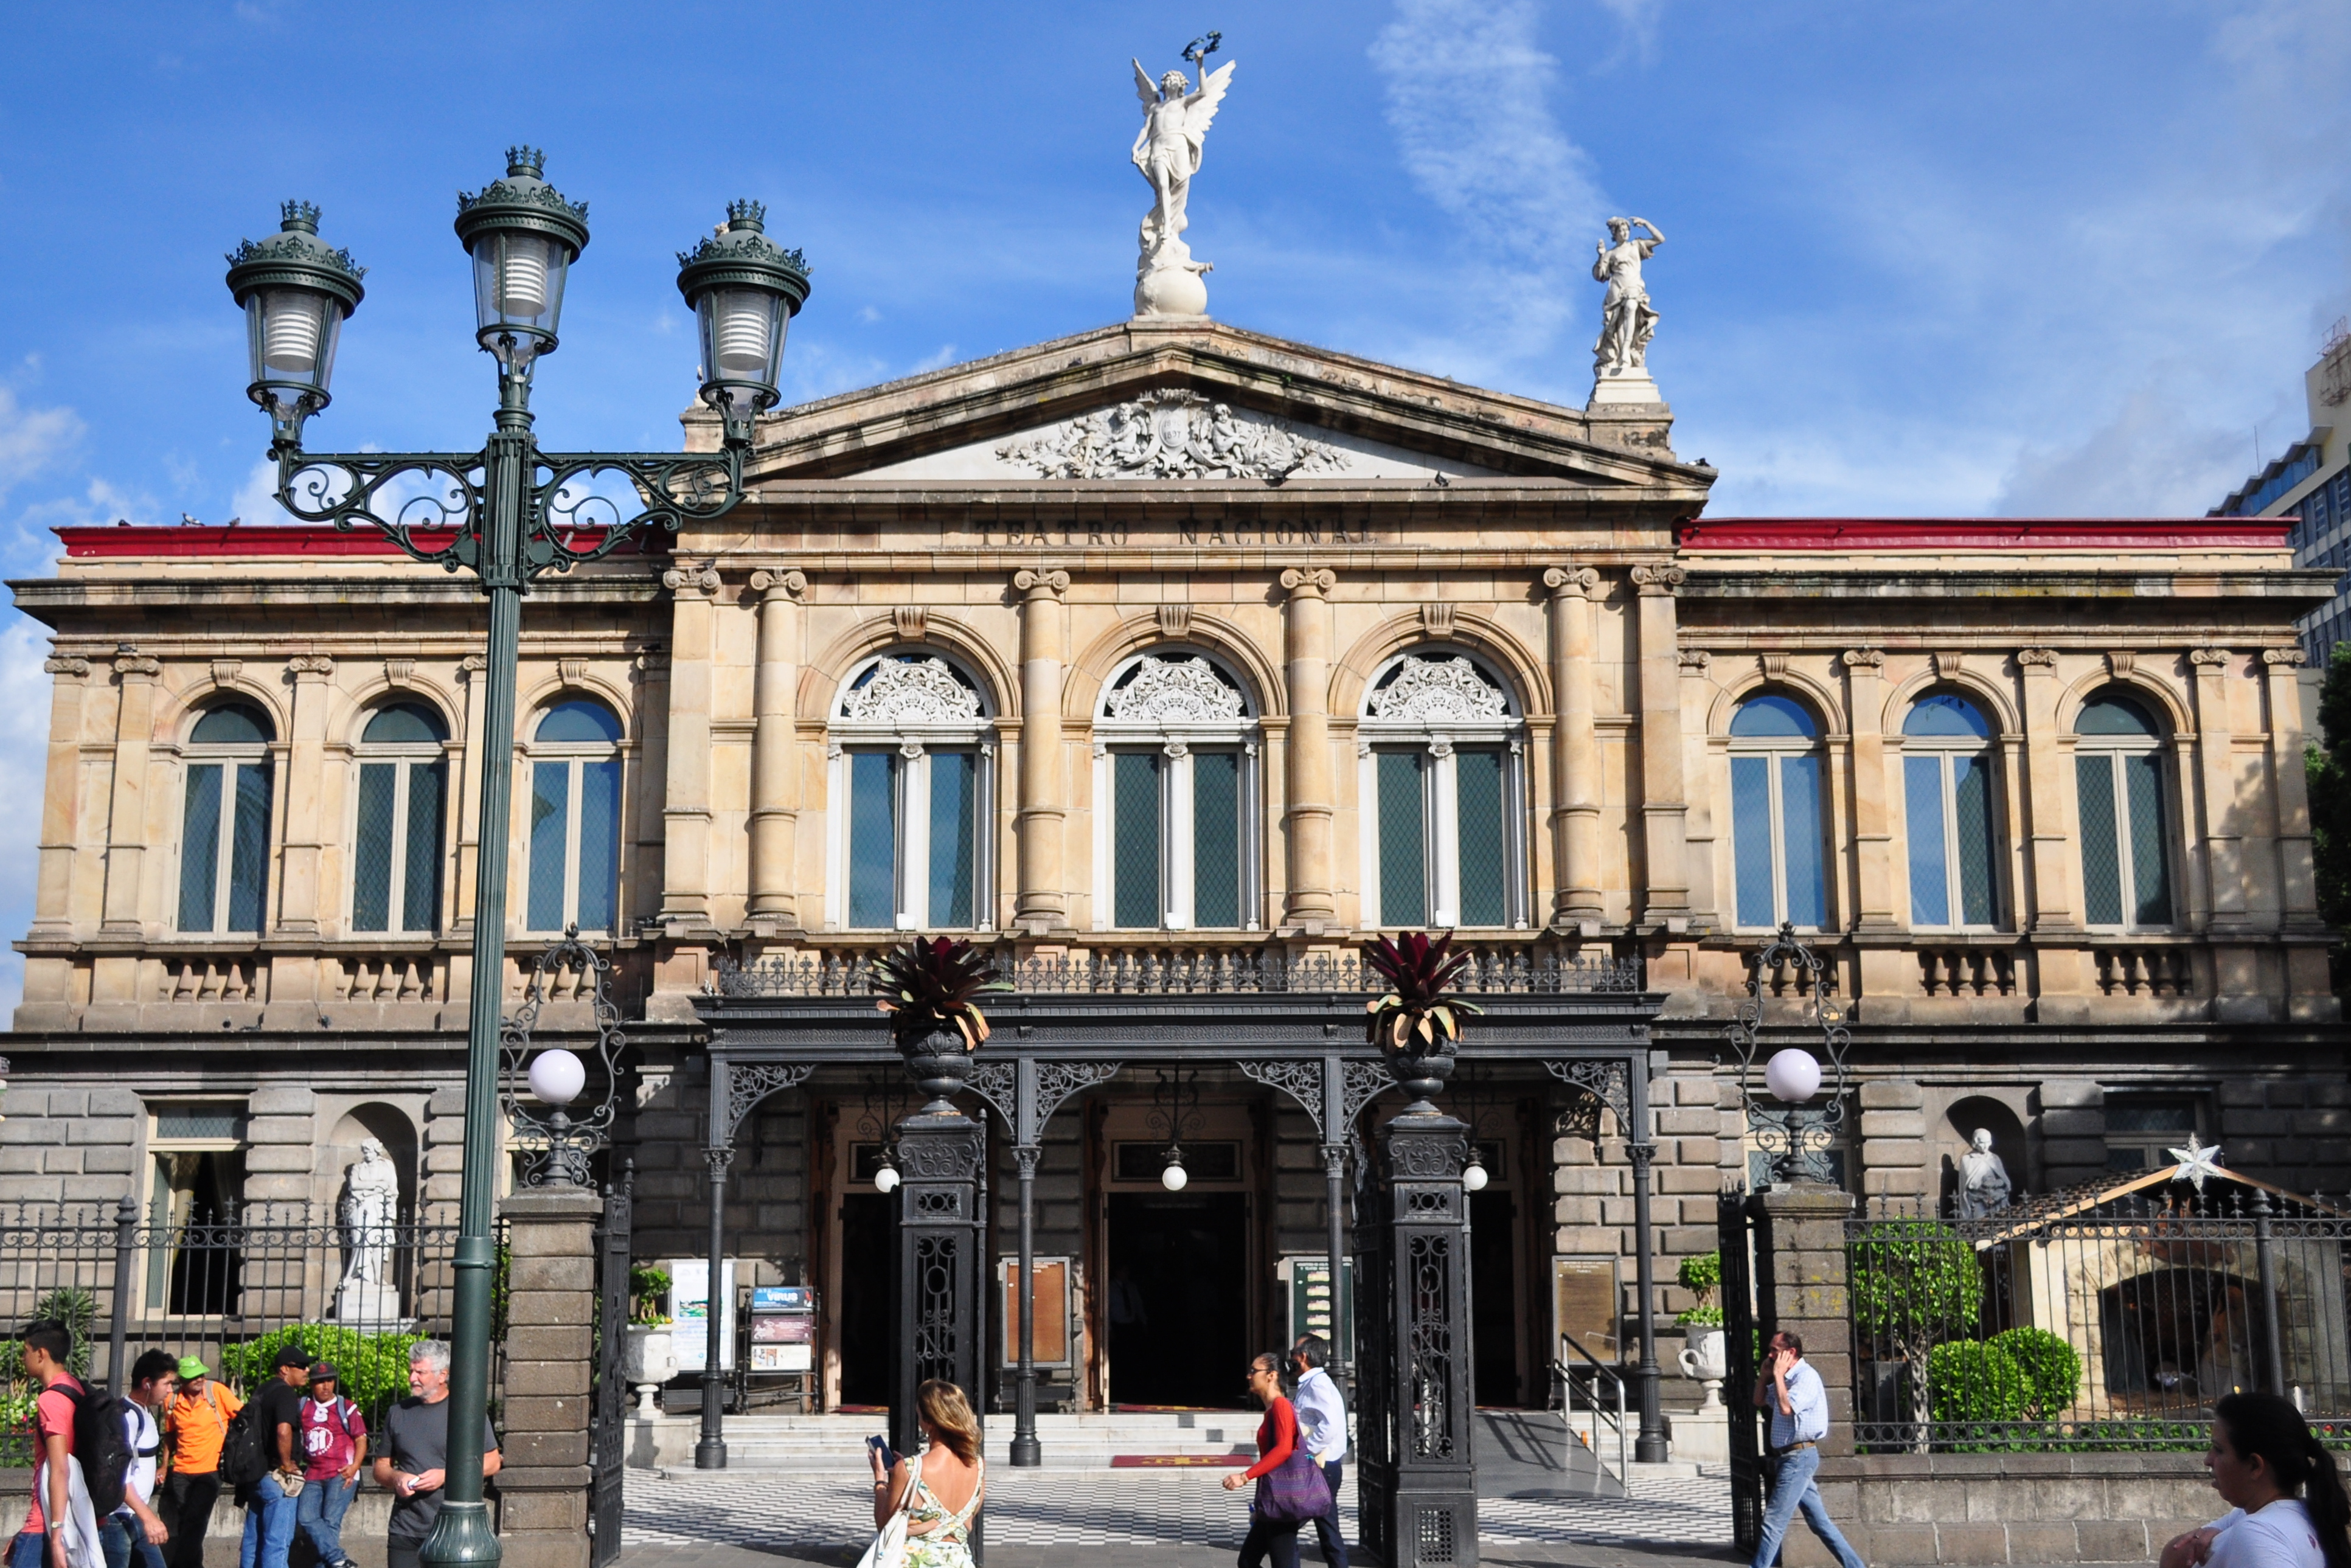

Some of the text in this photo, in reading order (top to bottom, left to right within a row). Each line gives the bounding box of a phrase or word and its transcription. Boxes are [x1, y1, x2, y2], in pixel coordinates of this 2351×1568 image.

[1164, 430, 1181, 440] 1897
[975, 519, 1377, 546] TEATRO NACIONAL
[766, 1292, 798, 1302] VIRUS
[309, 1430, 327, 1452] 31
